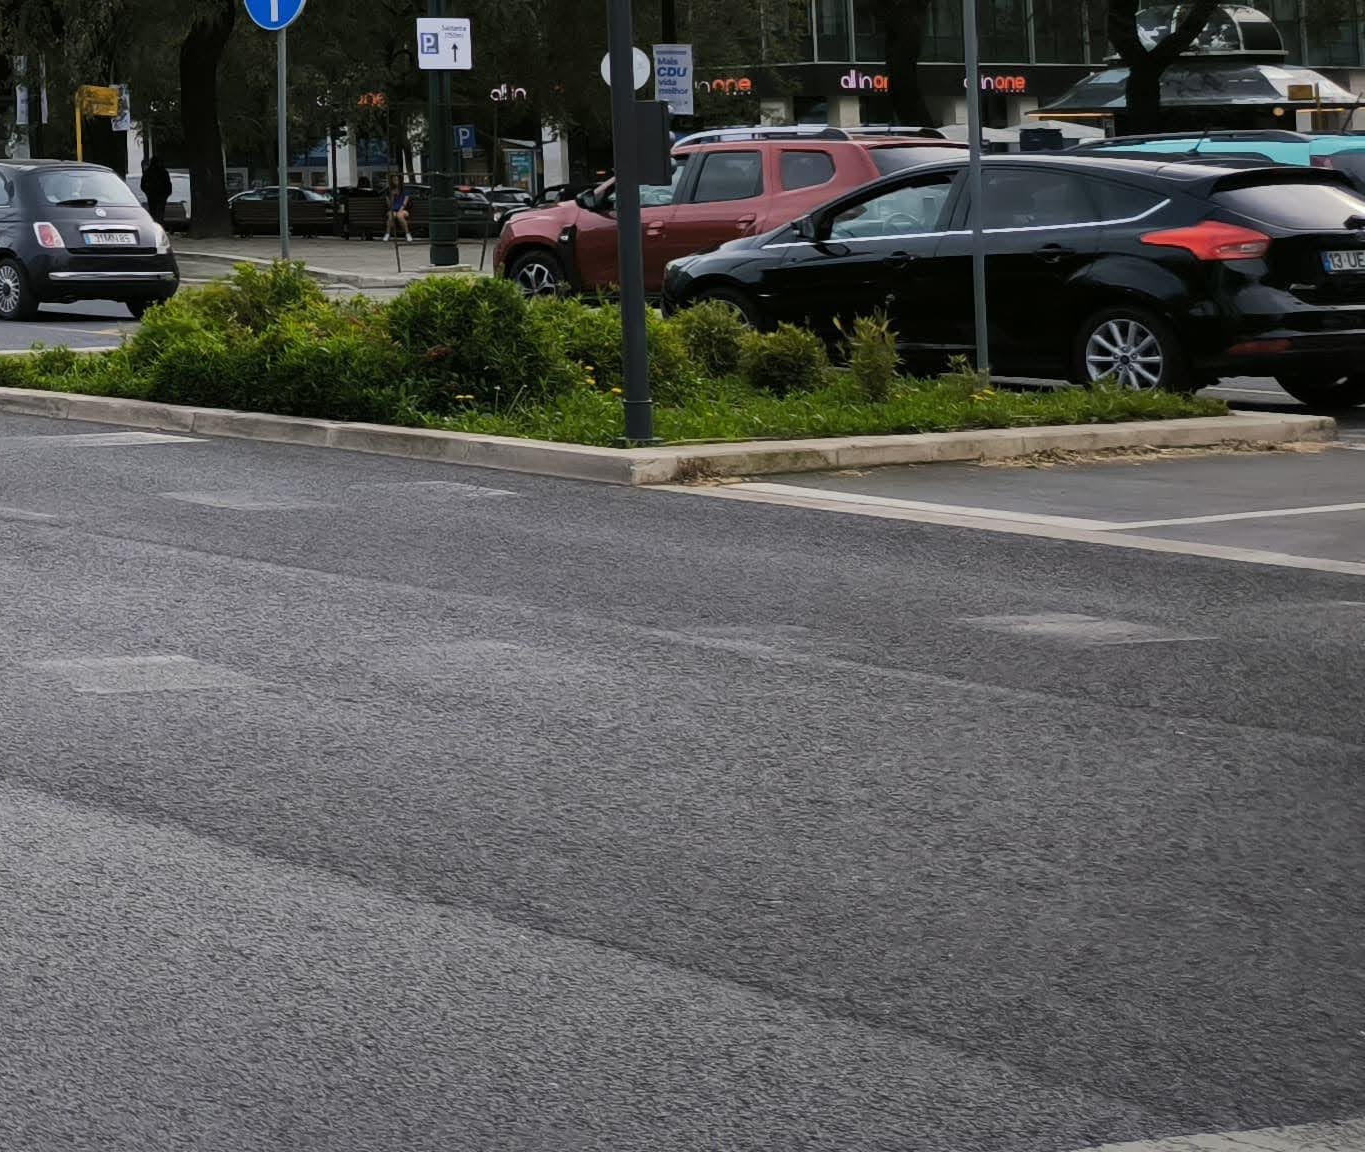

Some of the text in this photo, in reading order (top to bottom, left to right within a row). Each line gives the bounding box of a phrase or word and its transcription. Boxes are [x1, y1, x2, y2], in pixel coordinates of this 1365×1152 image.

[657, 57, 678, 65] Mais
[657, 67, 687, 77] CDU
[840, 69, 856, 89] all
[858, 72, 873, 89] in
[980, 74, 994, 90] in
[995, 76, 1027, 89] one
[660, 87, 688, 95] melhor
[458, 127, 470, 146] P
